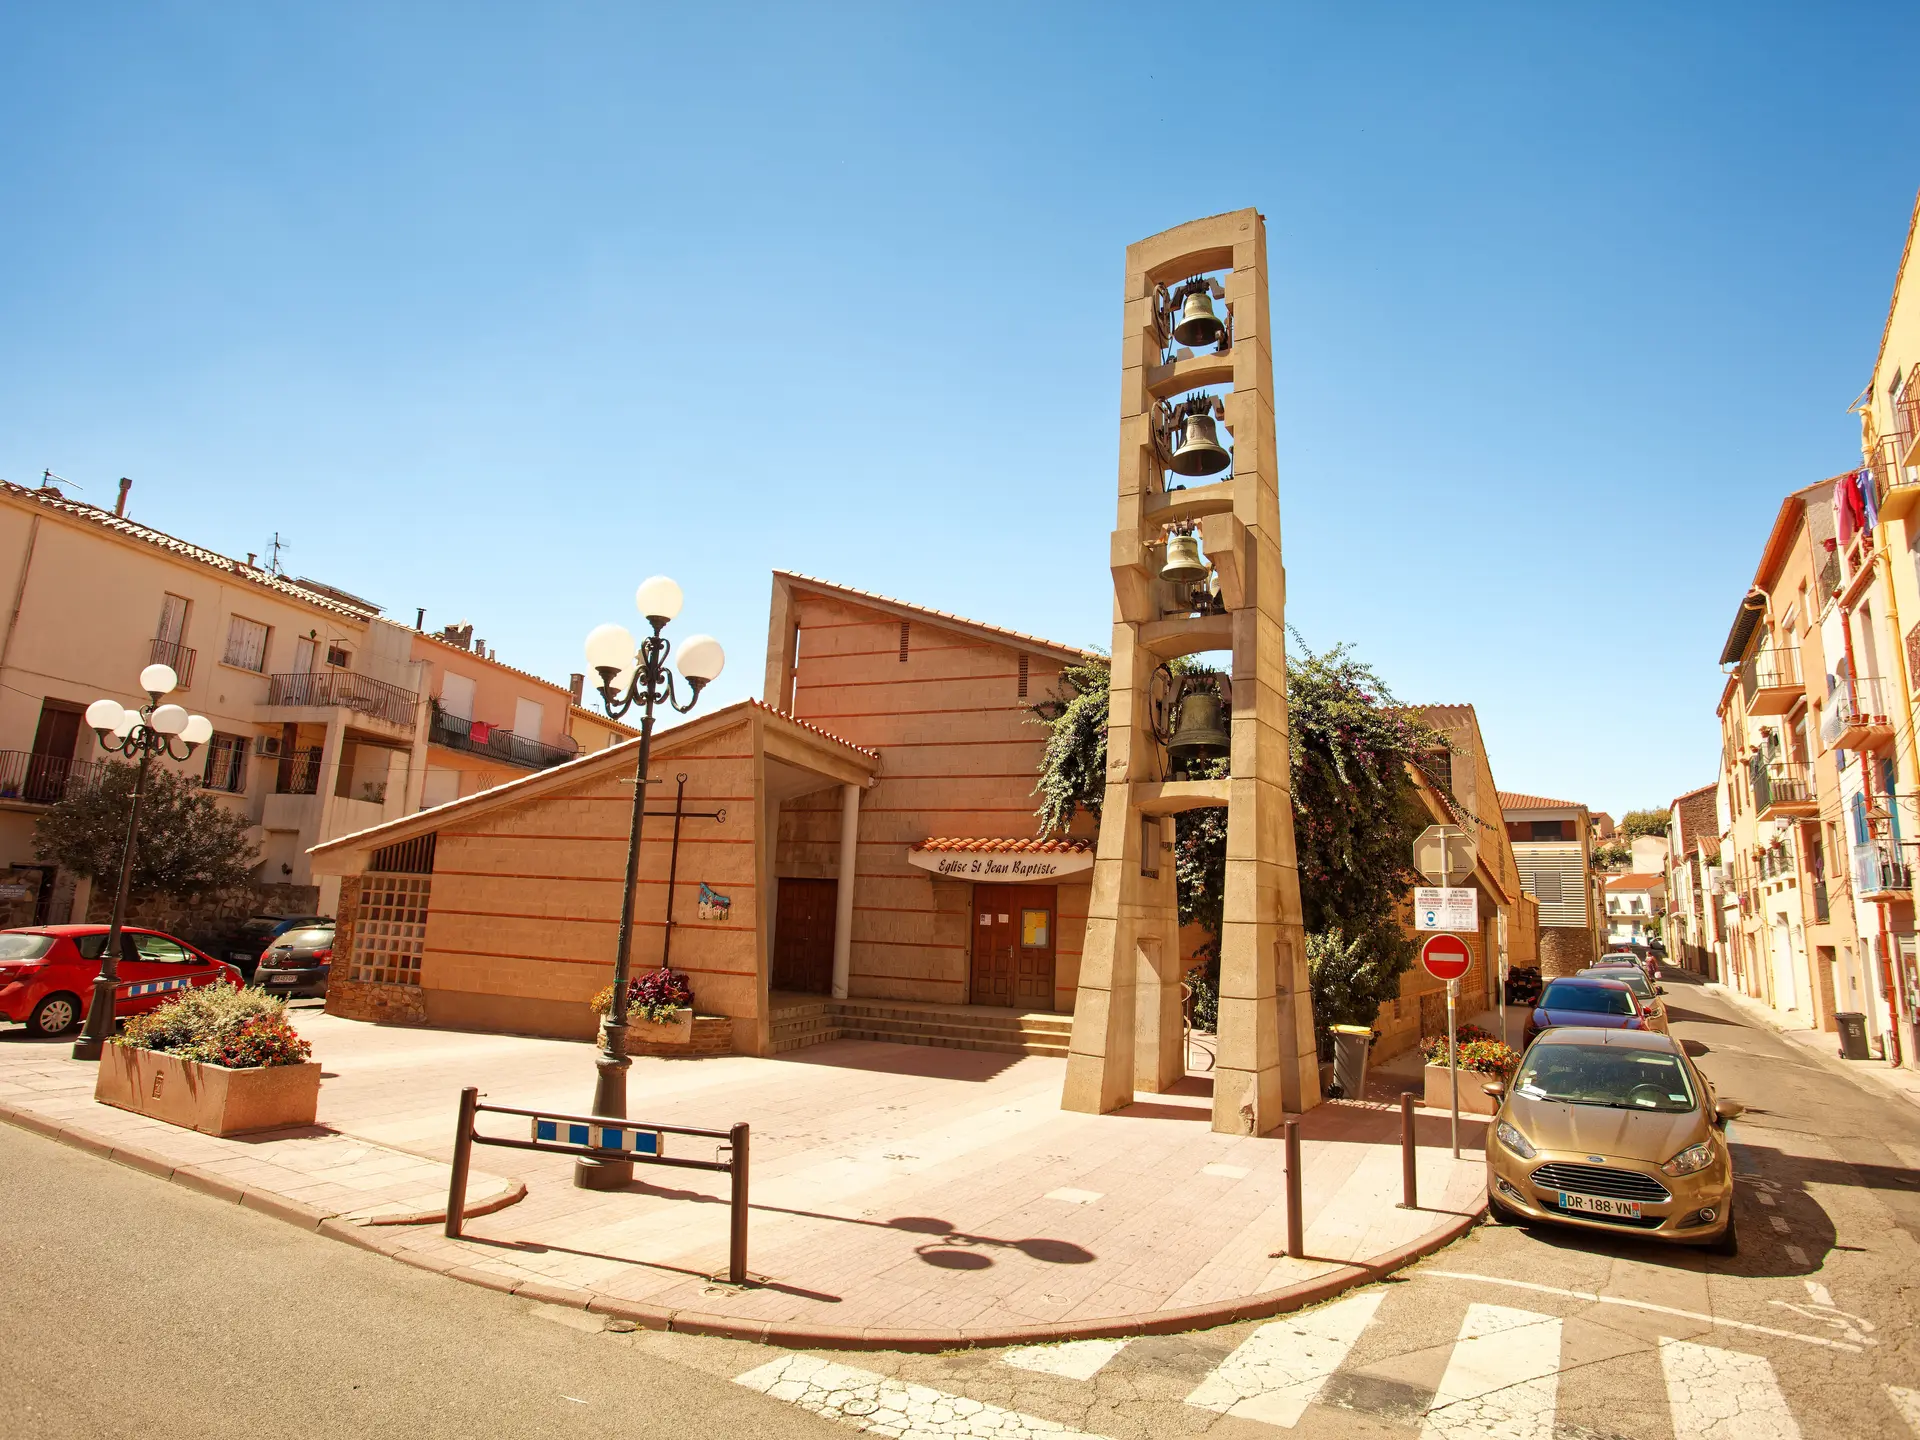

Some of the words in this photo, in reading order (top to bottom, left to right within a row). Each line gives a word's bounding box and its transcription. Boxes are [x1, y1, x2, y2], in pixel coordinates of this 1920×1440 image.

[938, 858, 968, 875] Eglise
[971, 859, 982, 874] St
[984, 859, 1009, 875] Jean
[1011, 860, 1057, 877] Baptiste
